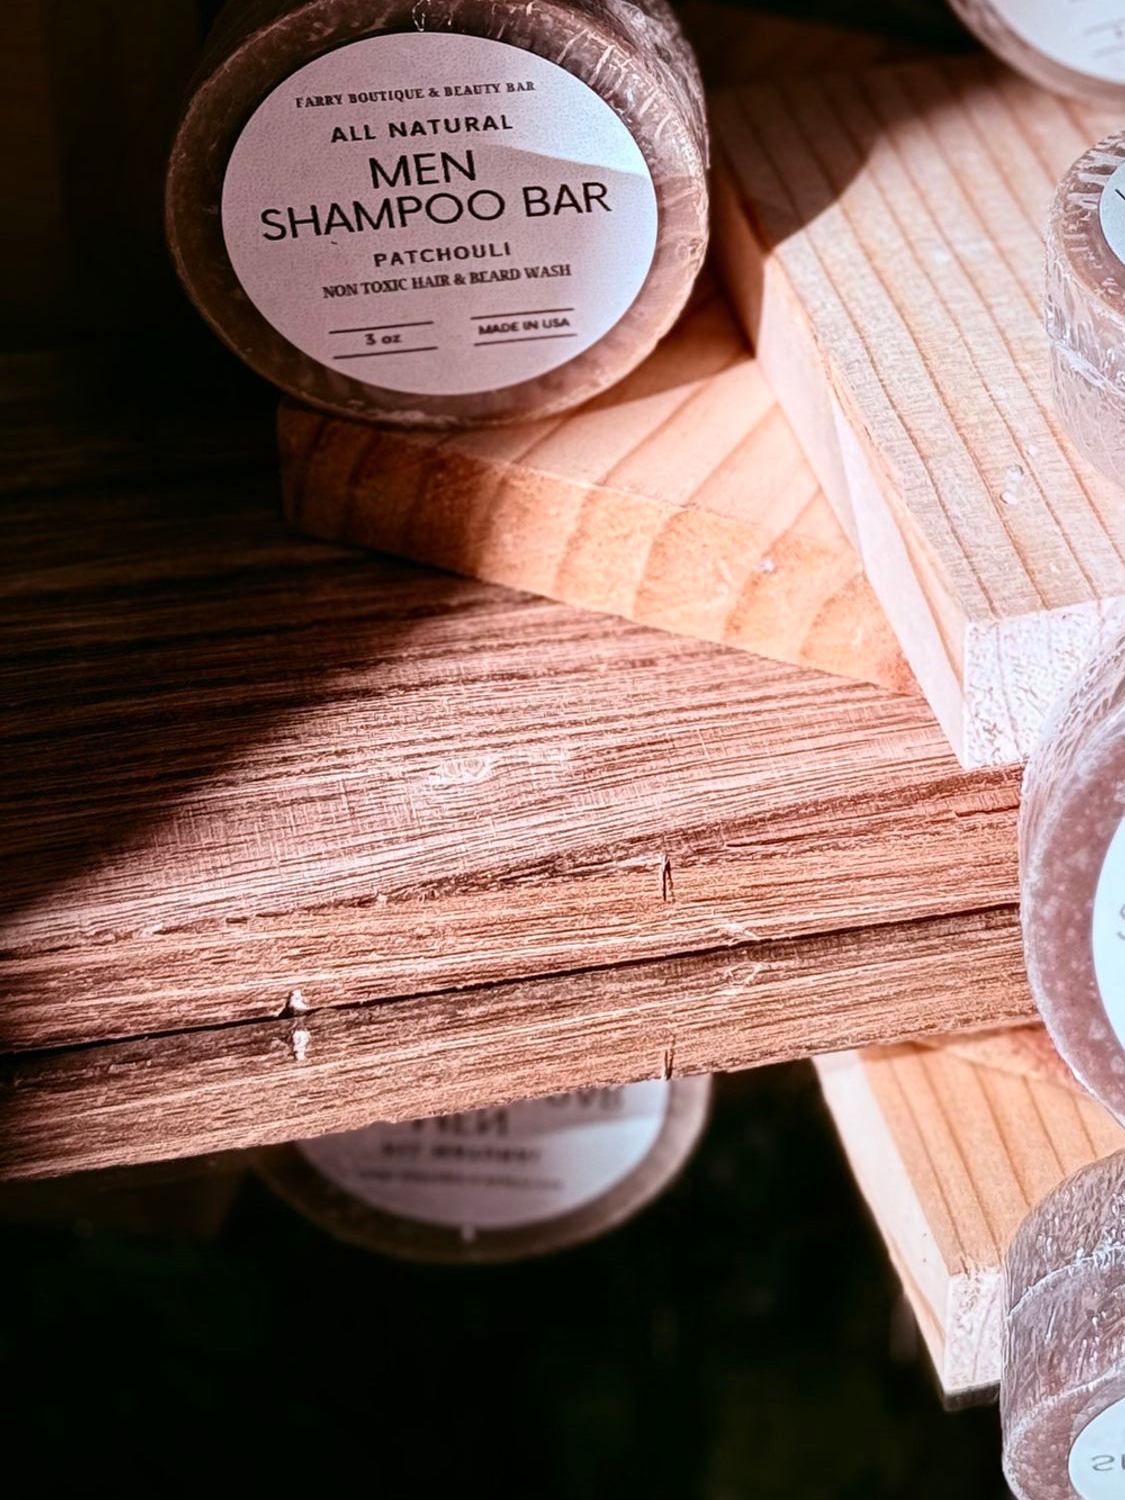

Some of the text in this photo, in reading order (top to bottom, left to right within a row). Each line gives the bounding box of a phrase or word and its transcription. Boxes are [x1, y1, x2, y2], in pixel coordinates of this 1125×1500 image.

[296, 80, 537, 109] FARRY BOUTIQUE & BEAUTY BAR
[330, 114, 514, 144] ALL NATURAL
[369, 149, 477, 190] MEN
[260, 181, 613, 241] SHAMPOO BAR
[373, 241, 512, 268] PATCHOULI
[322, 263, 572, 300] NON TOXIC HAIR & BEARD WASH
[364, 332, 404, 345] 3 oz
[478, 316, 571, 336] MADE IN USA
